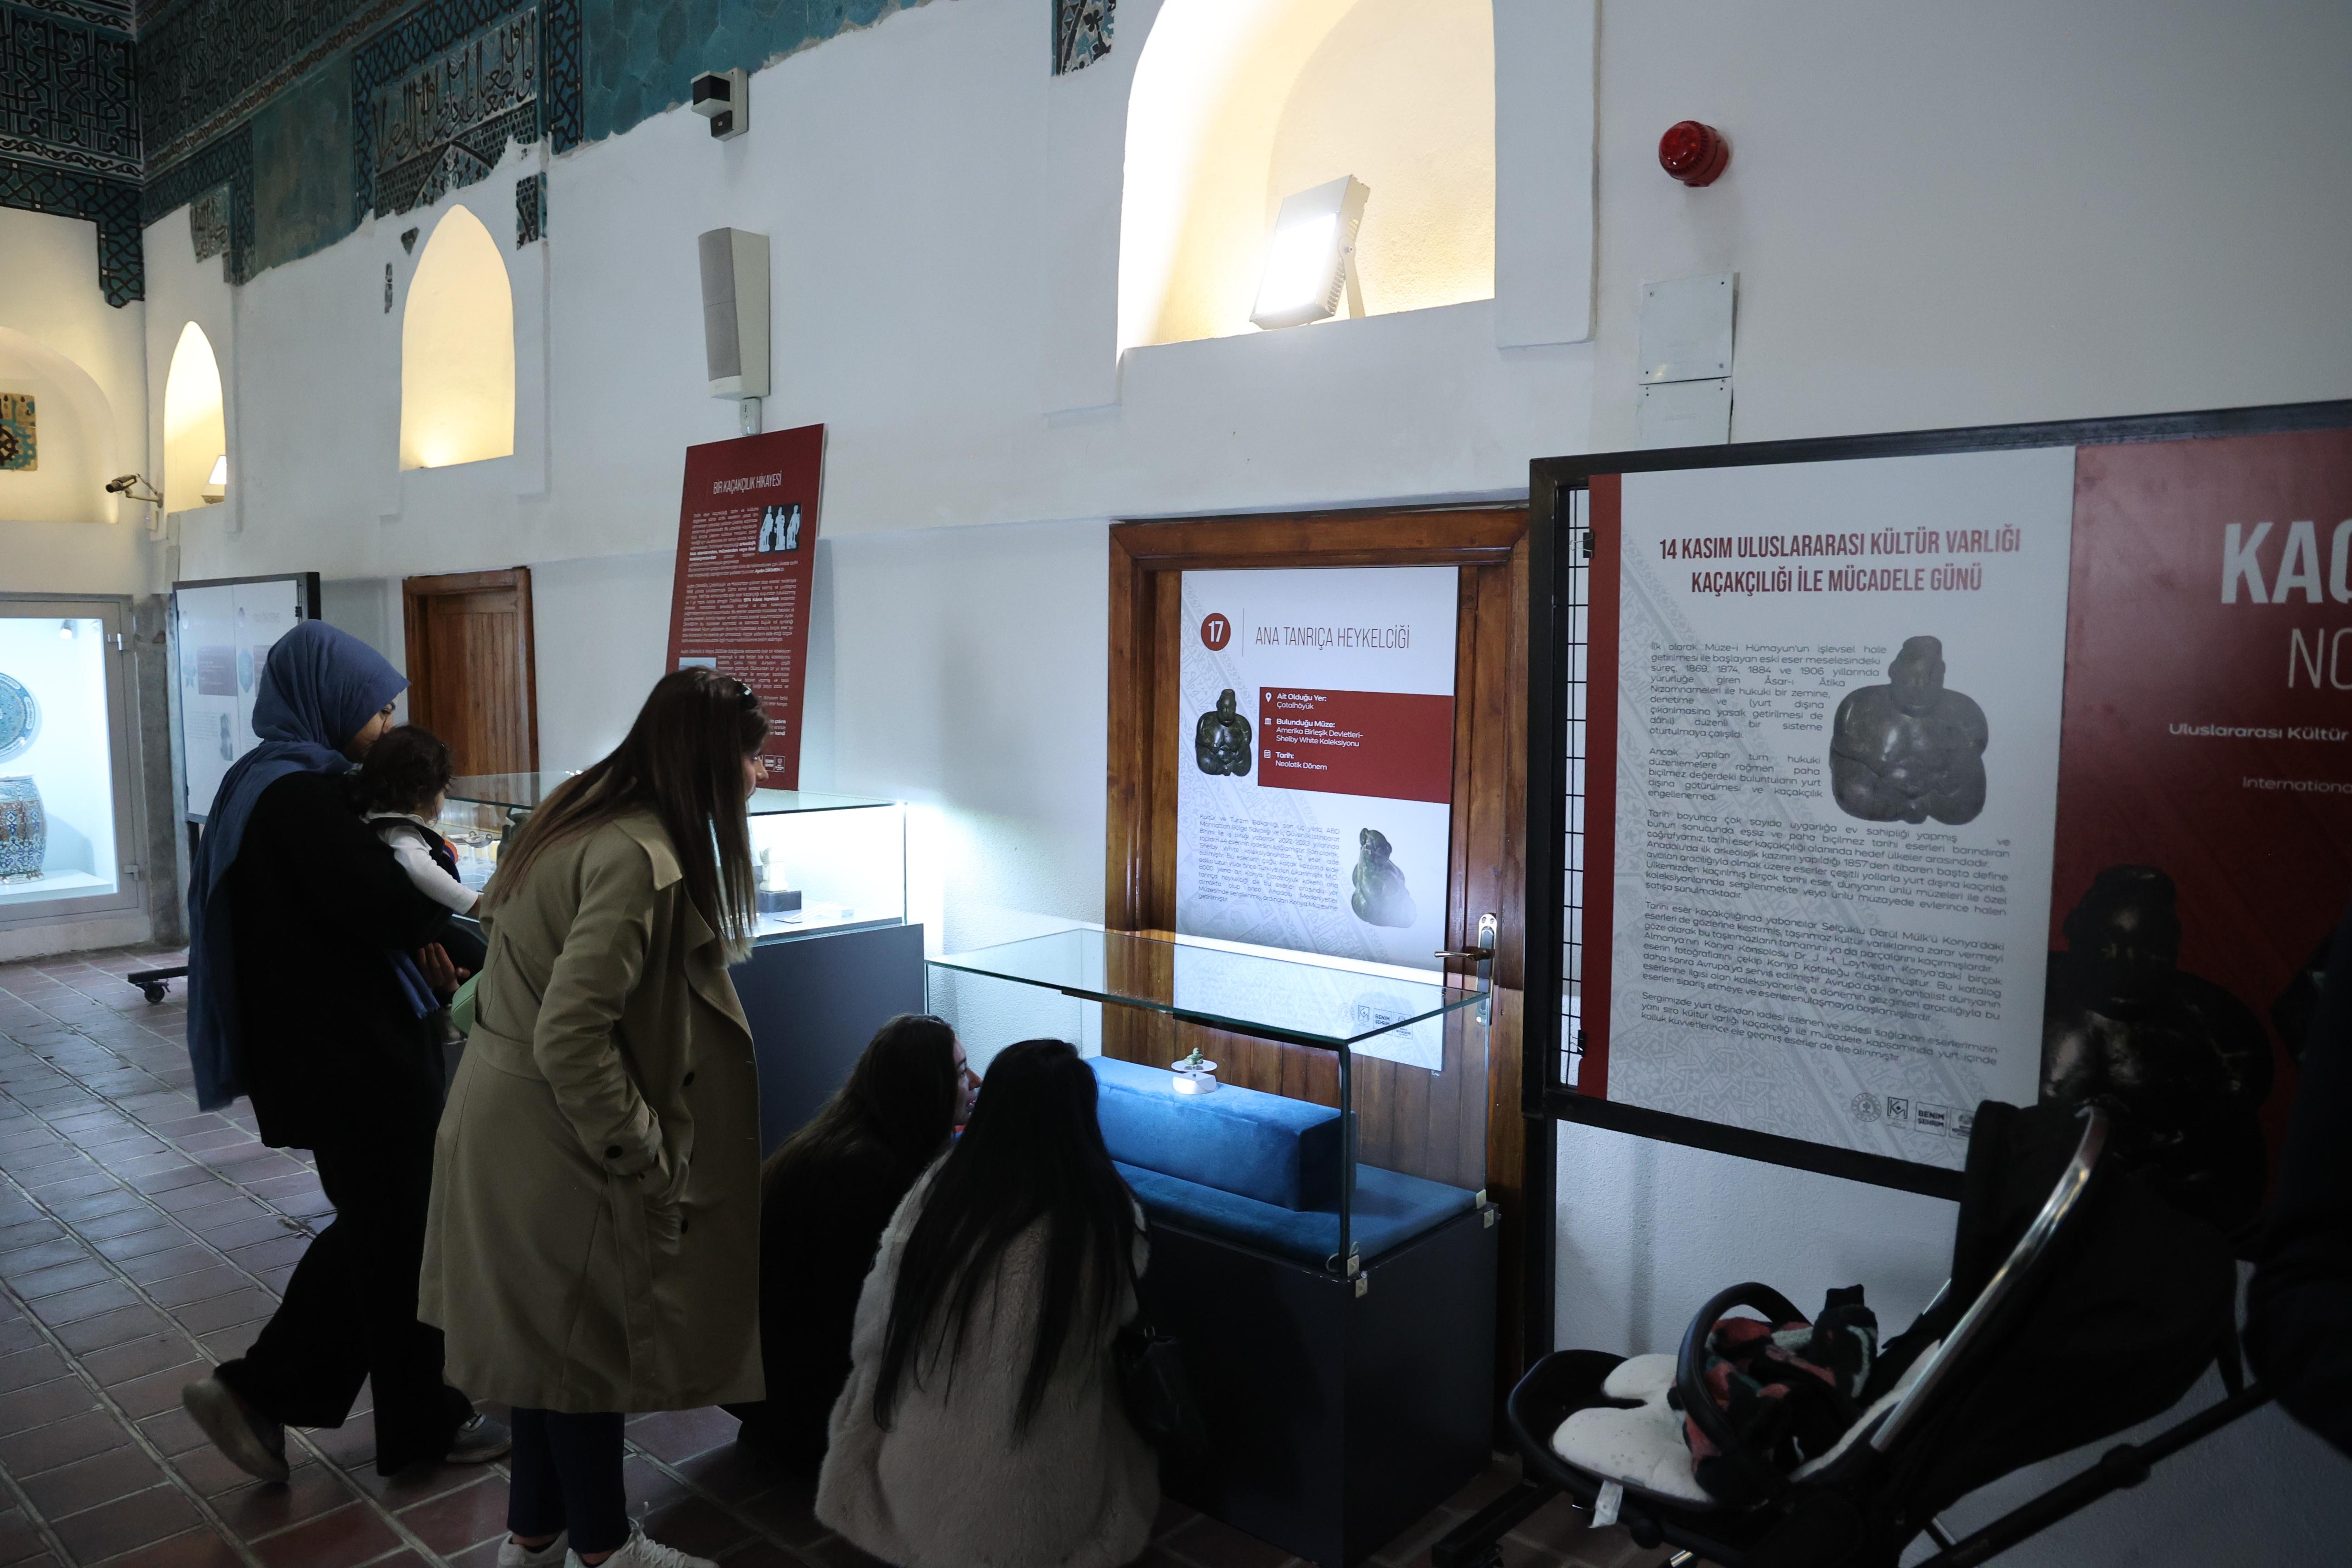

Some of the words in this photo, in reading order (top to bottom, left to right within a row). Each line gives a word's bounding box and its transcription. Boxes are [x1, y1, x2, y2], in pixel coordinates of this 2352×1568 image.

[1660, 539, 1677, 559] 14
[1682, 537, 1732, 559] KASIM
[1738, 533, 1864, 558] ULUSLARARASI
[1871, 526, 1939, 555] KÜLTÜR
[1946, 523, 2021, 553] VARLIĞI
[1692, 565, 1792, 597] KAÇAKÇILIĞI
[1798, 565, 1823, 592] İLE
[1829, 564, 1925, 592] MÜCADELE
[1931, 563, 1982, 591] GÜNÜ
[1208, 620, 1224, 643] 17
[1255, 626, 1279, 645] ANA
[1283, 627, 1333, 650] TANRIÇA
[1338, 624, 1409, 649] HEYKELCİĞİ
[1817, 645, 1856, 654] işlevsel
[1863, 645, 1887, 654] hale
[1713, 654, 1757, 664] başlayan
[1748, 666, 1771, 674] 1884
[1801, 666, 1824, 675] 1906
[1716, 676, 1741, 686] giren
[1739, 687, 1771, 695] hukuki
[1277, 701, 1314, 710] Çatalhöyük
[1650, 695, 1694, 704] denetime
[1716, 709, 1746, 718] yasak
[1276, 718, 1313, 728] Bulunduğu
[1782, 722, 1823, 731] sisteme
[1305, 728, 1328, 737] Birleşik
[1649, 727, 1706, 738] oturtulmaya
[2169, 723, 2283, 738] Uluslararası
[2288, 727, 2349, 741] Kültür
[1276, 735, 1298, 744] Shelby
[1319, 738, 1360, 747] Koleksiyonu
[1649, 747, 1679, 756] Ancak
[1696, 750, 1730, 760] yapılan
[1787, 755, 1821, 764] hukuki
[1736, 763, 1774, 773] rağmen
[1793, 767, 1820, 776] paha
[1689, 770, 1736, 781] değerdeki
[1801, 779, 1821, 788] yurt
[1648, 809, 1669, 818] Tarih
[1677, 812, 1717, 823] boyunca
[1724, 816, 1742, 825] çok
[1749, 819, 1782, 829] sayıda
[1790, 823, 1837, 834] uygarlığa
[1917, 833, 1958, 844] yapmış
[1647, 819, 1676, 829] bunun
[1681, 824, 1734, 834] sonucunda
[1740, 829, 1764, 838] eşsiz
[1789, 833, 1815, 842] paha
[1905, 843, 1945, 852] eserleri
[1807, 844, 1852, 855] alanında
[1854, 848, 1885, 858] hedef
[1646, 840, 1698, 852] Anadolu'da
[1713, 847, 1759, 859] arkeolojik
[1844, 858, 1889, 870] 1857'den
[1937, 867, 1969, 879] başta
[1973, 870, 2008, 881] define
[1730, 859, 1761, 869] olmak
[1793, 866, 1827, 875] eserler
[1862, 872, 1900, 882] yollarla
[1903, 877, 1924, 886] yurt
[1749, 871, 1779, 882] birçok
[1645, 883, 1672, 892] satışa
[1729, 881, 1798, 894] sergilenmekte
[1803, 889, 1826, 899] veya
[1919, 901, 1969, 912] evlerince
[1974, 905, 2007, 916] halen
[1667, 925, 1696, 935] alarak
[1698, 928, 1710, 936] bu
[1829, 946, 1842, 955] ya
[1844, 946, 1858, 955] da
[1678, 915, 1690, 924] de
[1927, 947, 1955, 956] zarar
[1704, 940, 1733, 952] Konya
[1739, 944, 1789, 958] Konsolosu
[1643, 952, 1666, 962] daha
[1668, 957, 1694, 965] sonra
[1767, 958, 1798, 971] Konya
[1803, 963, 1849, 978] Kataloğu
[1937, 981, 1952, 990] Bu
[1958, 983, 2001, 999] katalog
[1707, 983, 1743, 995] etmeye
[1710, 972, 1730, 981] olan
[1985, 1010, 2000, 1020] bu
[1694, 1002, 1712, 1010] yurt
[1875, 1030, 1925, 1043] sağlanan
[1641, 1011, 1666, 1022] kolluk
[1730, 1027, 1745, 1036] ele
[1784, 1037, 1817, 1048] eserler
[1820, 1041, 1832, 1050] de
[1835, 1044, 1850, 1053] ele
[1937, 1050, 1959, 1060] yurt
[1918, 1110, 1945, 1121] BENİM
